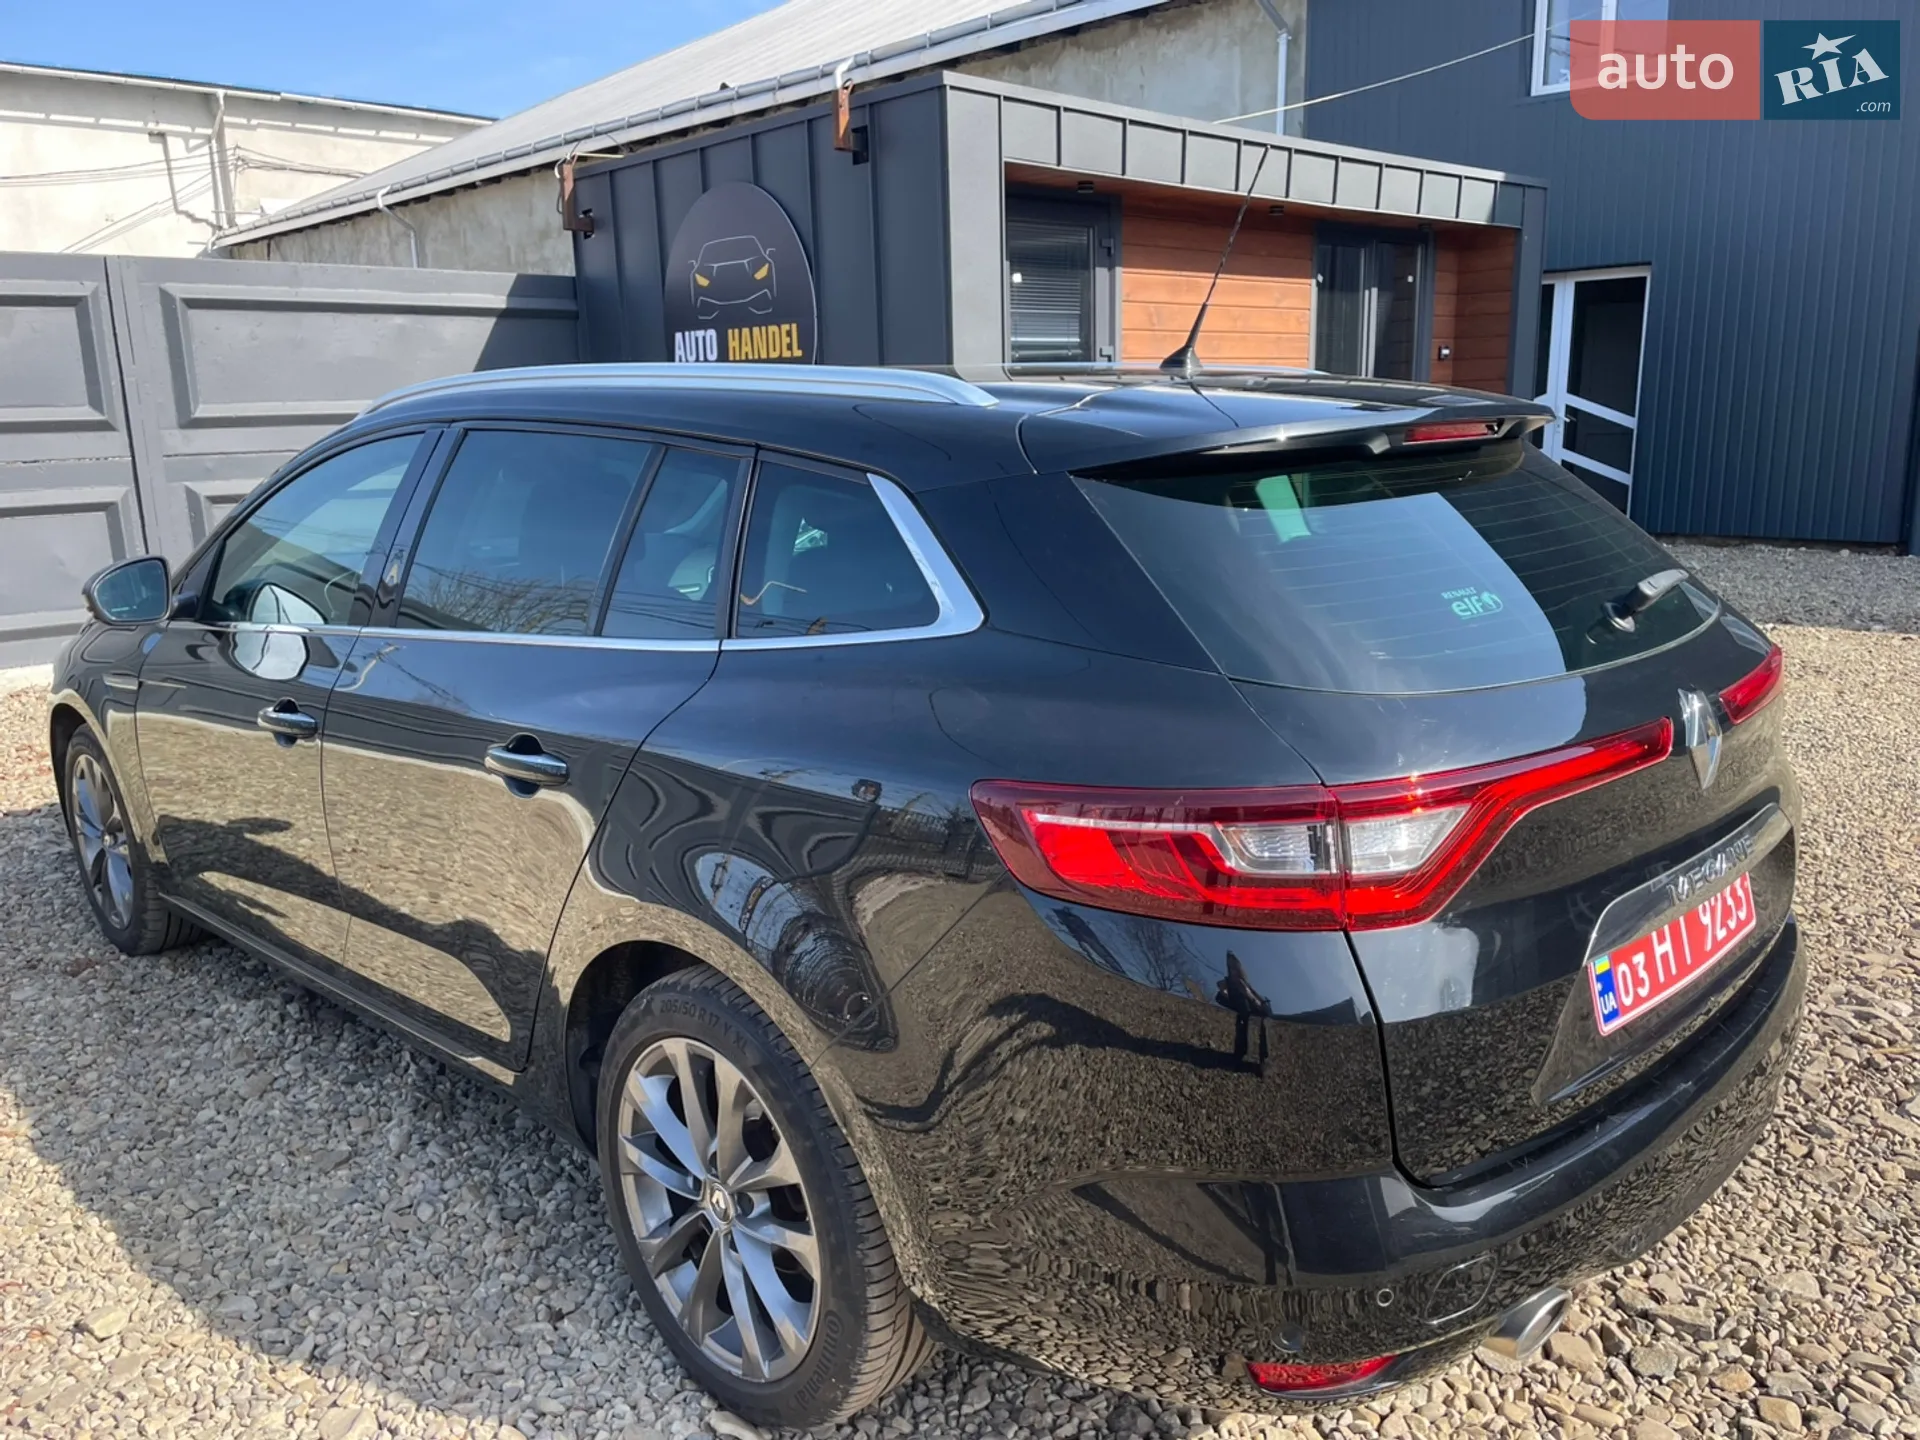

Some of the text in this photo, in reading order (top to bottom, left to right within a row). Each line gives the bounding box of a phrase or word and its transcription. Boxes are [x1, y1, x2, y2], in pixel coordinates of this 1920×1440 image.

[674, 323, 803, 363] AUTO HANDEL
[1451, 596, 1483, 616] elf
[1617, 952, 1650, 1007] 03
[1698, 878, 1748, 952] 9233
[659, 999, 697, 1018] 205/50
[708, 1013, 720, 1028] 17
[1600, 995, 1617, 1015] UA
